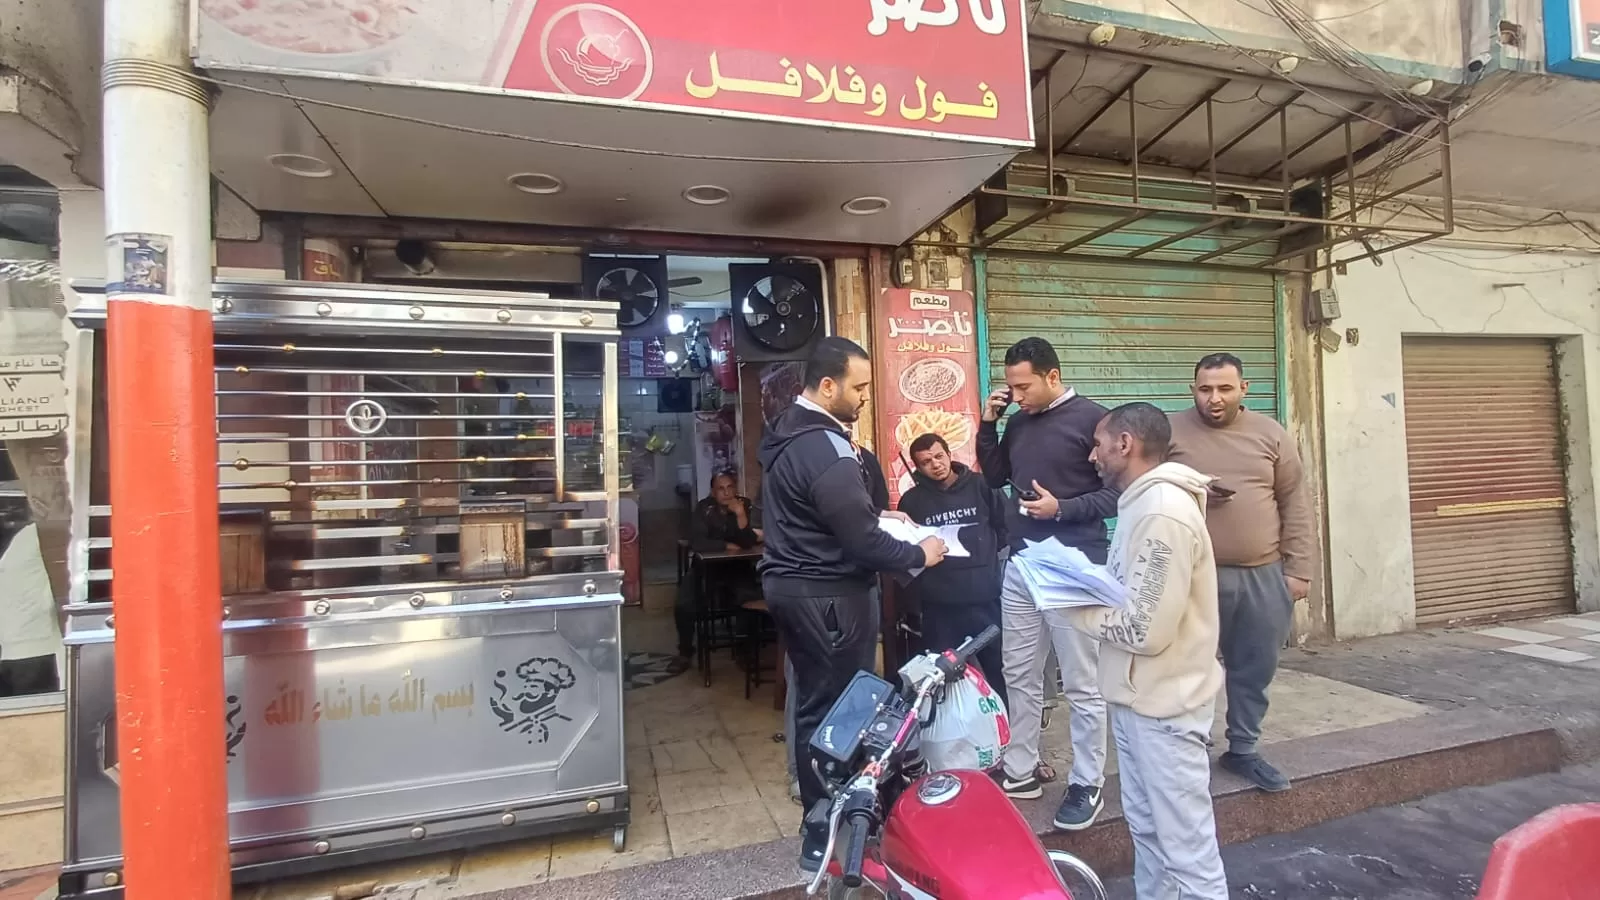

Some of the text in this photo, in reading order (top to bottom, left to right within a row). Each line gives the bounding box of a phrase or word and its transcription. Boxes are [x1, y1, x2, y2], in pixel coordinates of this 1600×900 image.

[684, 51, 998, 123] فول وفلافل
[912, 295, 948, 306] مطعم
[888, 311, 973, 338] ناصر
[0, 396, 50, 405] LIANO
[925, 507, 977, 526] GIVENCHY
[359, 683, 382, 717] ما
[431, 677, 476, 724] بسم
